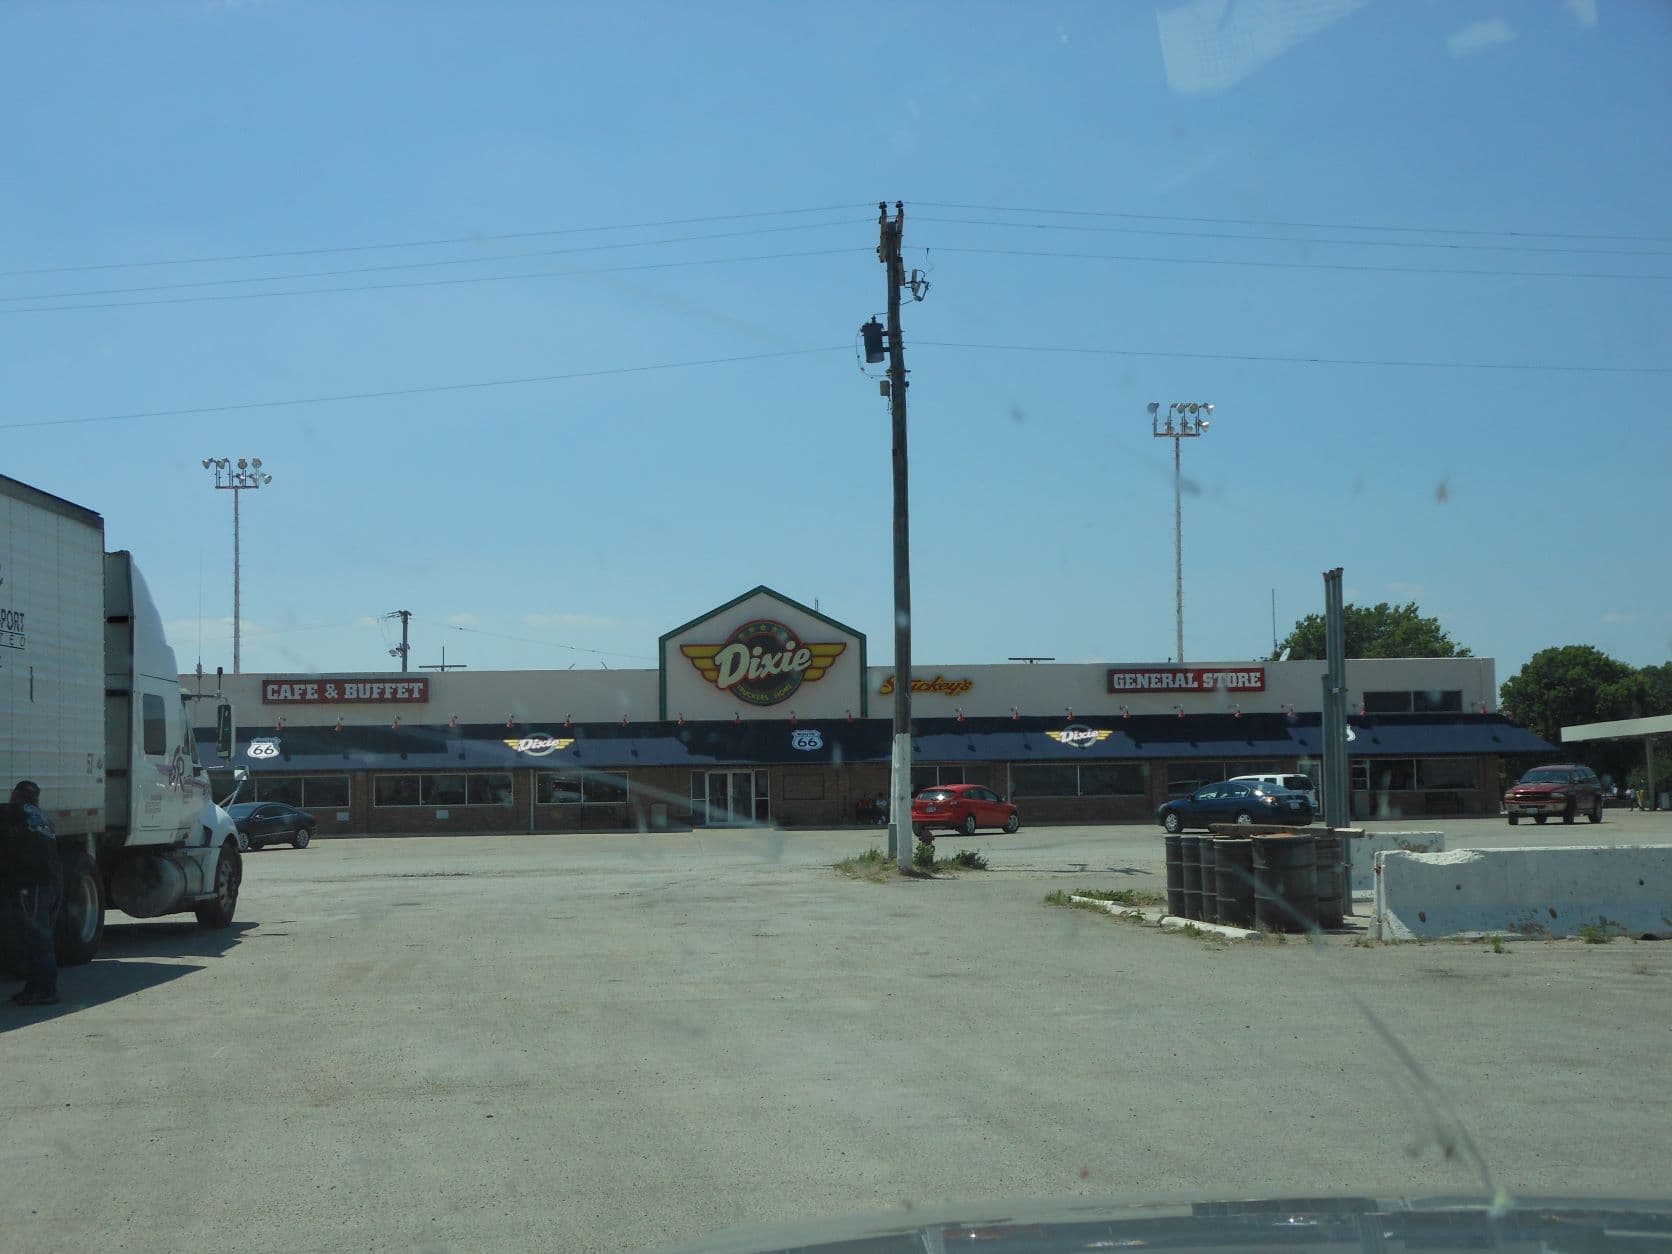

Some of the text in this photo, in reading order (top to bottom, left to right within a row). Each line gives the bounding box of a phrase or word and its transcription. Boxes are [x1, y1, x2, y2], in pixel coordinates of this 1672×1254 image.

[714, 640, 812, 689] Dixie
[1113, 672, 1262, 689] GENERAL STORE
[266, 682, 424, 700] CAFE & BUFFET
[797, 737, 818, 747] 66
[1059, 729, 1099, 743] Dixie
[253, 745, 275, 755] 66
[517, 737, 560, 752] Dixie
